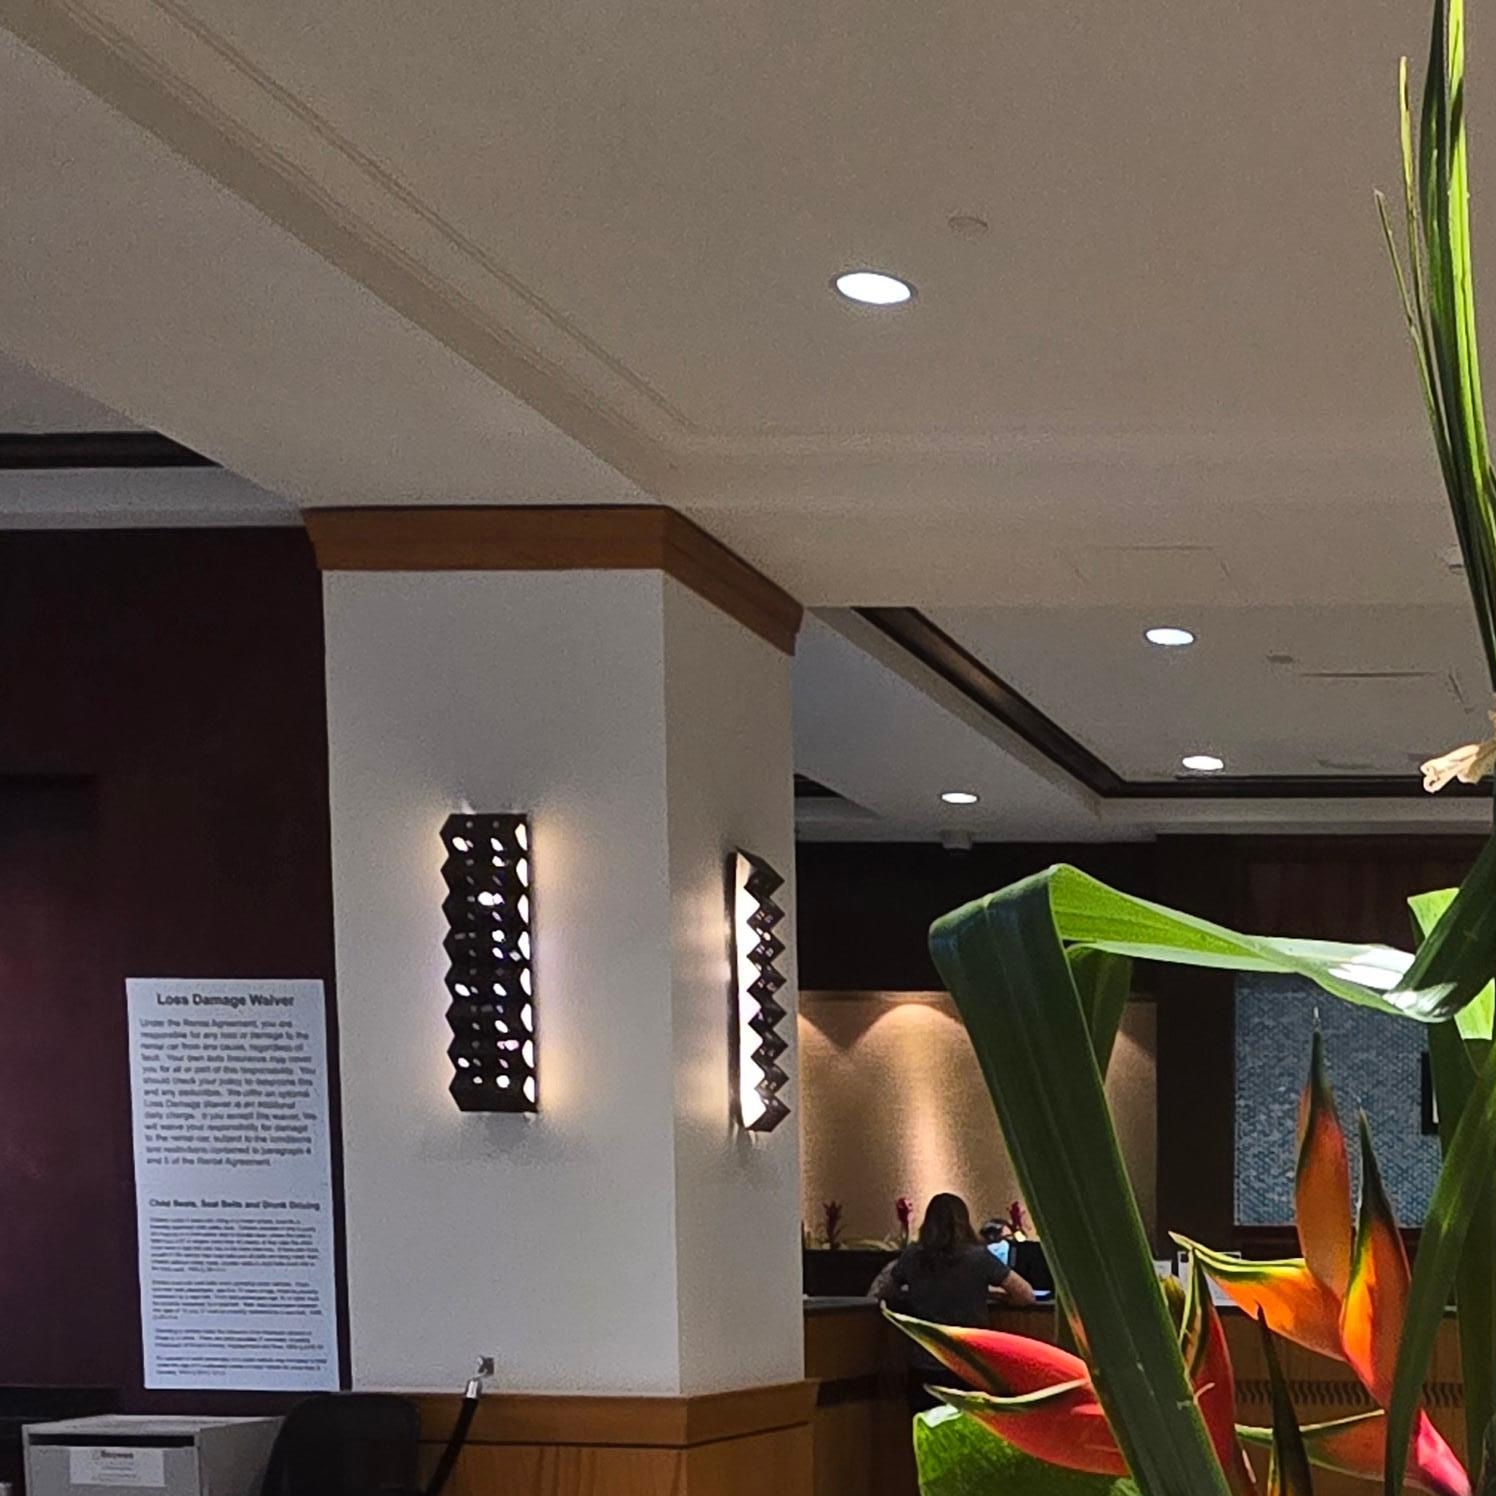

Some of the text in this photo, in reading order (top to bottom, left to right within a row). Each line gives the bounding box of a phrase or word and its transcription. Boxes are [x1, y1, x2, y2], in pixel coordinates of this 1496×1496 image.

[156, 992, 295, 1009] Loss Damage Waiver
